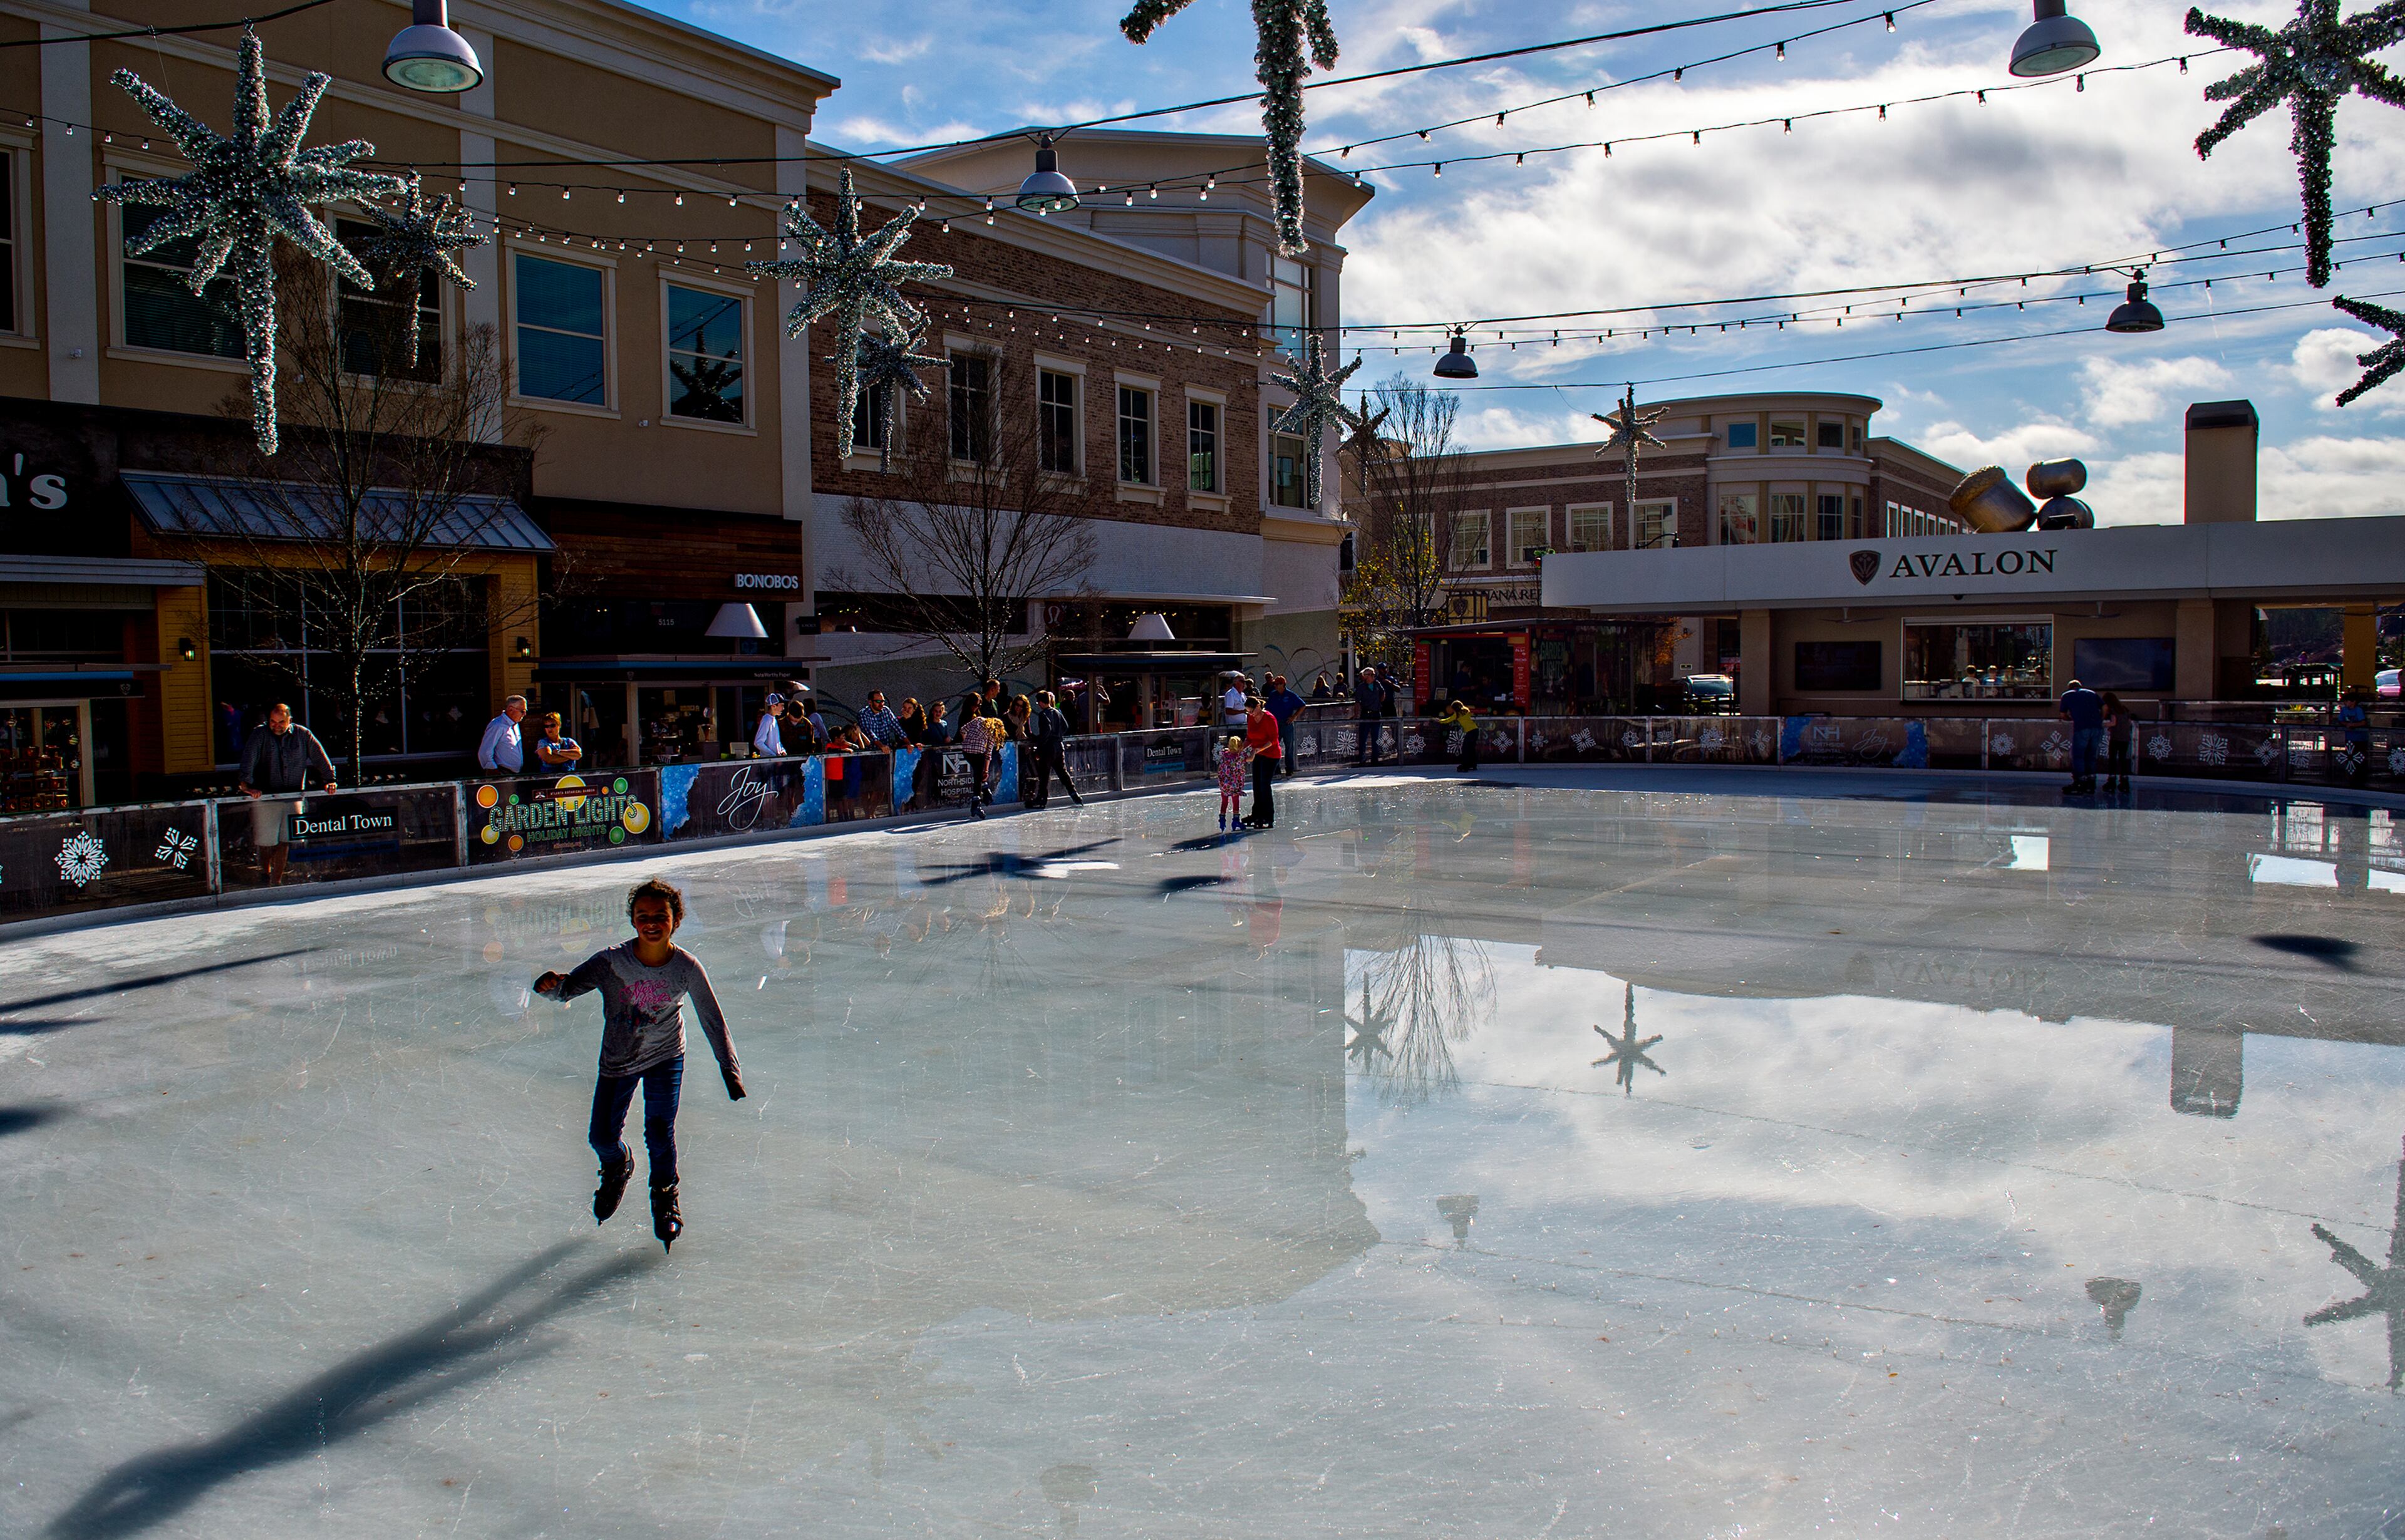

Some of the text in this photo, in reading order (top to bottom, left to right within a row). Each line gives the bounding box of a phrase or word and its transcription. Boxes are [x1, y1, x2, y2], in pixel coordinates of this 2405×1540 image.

[1889, 550, 2057, 577] AVALON
[734, 573, 799, 589] BONOBOS
[1147, 746, 1182, 757] Dental Town
[1853, 728, 1896, 760] Joy
[716, 765, 779, 830] Joy
[941, 787, 975, 797] HOSPITAL
[489, 794, 638, 832] GARDEN LIGHTS
[295, 814, 393, 835] Dental Town
[527, 824, 608, 842] HOLIDAY NIGHTS
